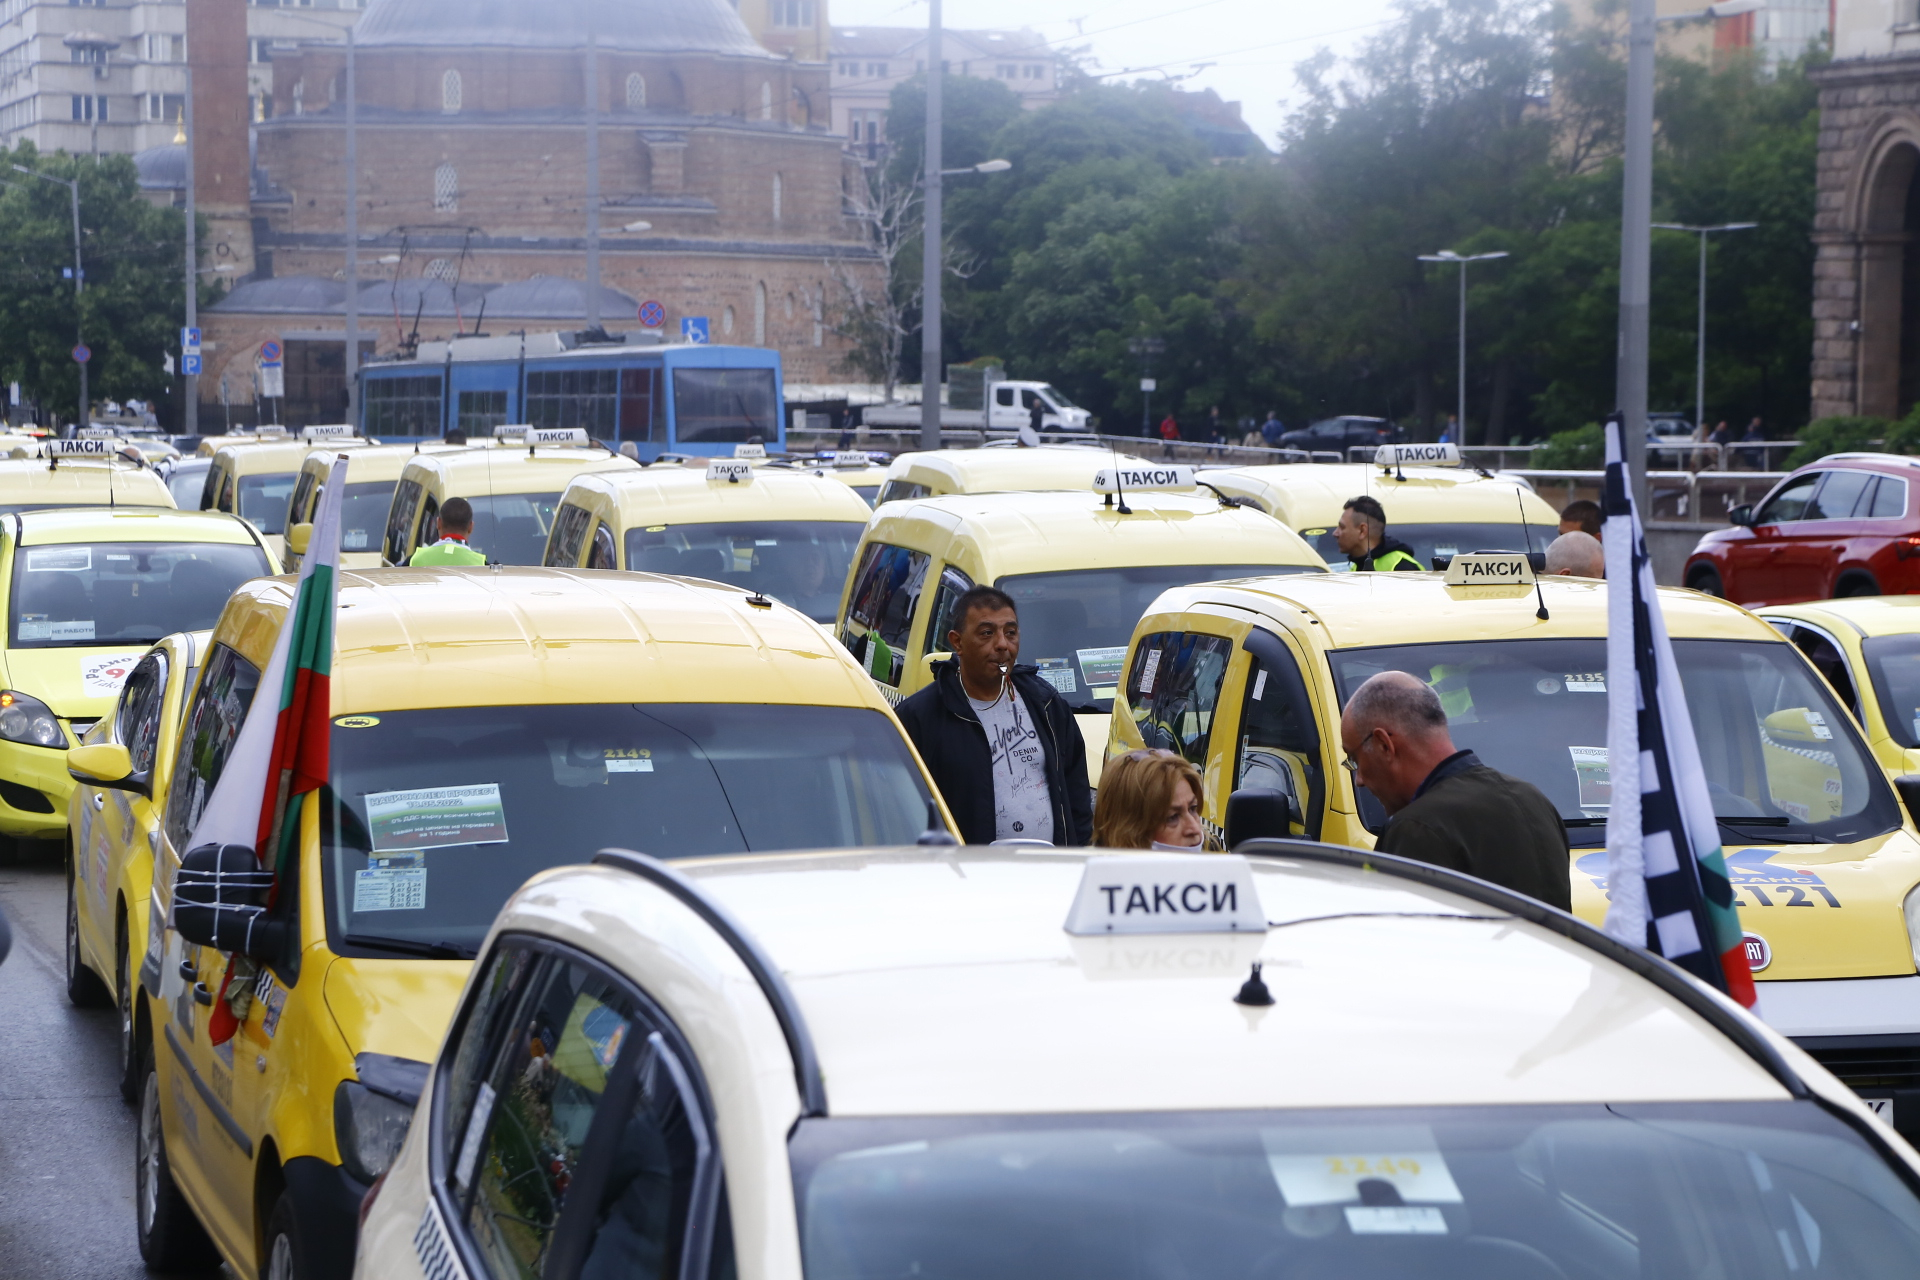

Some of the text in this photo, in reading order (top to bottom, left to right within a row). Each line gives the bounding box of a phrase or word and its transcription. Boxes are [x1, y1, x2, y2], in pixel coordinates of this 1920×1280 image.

[315, 427, 344, 435] ТАКСИ
[536, 432, 574, 442] ТАКСИ
[60, 441, 104, 453] ТАКСИ
[839, 454, 865, 462] ТАКСИ
[1396, 447, 1447, 461] ТАКСИ
[714, 465, 749, 474] ТАКСИ
[1121, 471, 1178, 486] ТАКСИ
[1461, 562, 1522, 576] ТАКСИ
[1564, 672, 1605, 682] 2135
[603, 748, 652, 759] 2149
[1013, 747, 1038, 757] DENIM
[1021, 755, 1036, 763] CO.
[370, 787, 497, 807] НАЦИОНАЛЕН ПРОТЕСТ
[403, 814, 421, 823] ДДС
[1100, 883, 1237, 915] ТАКСИ
